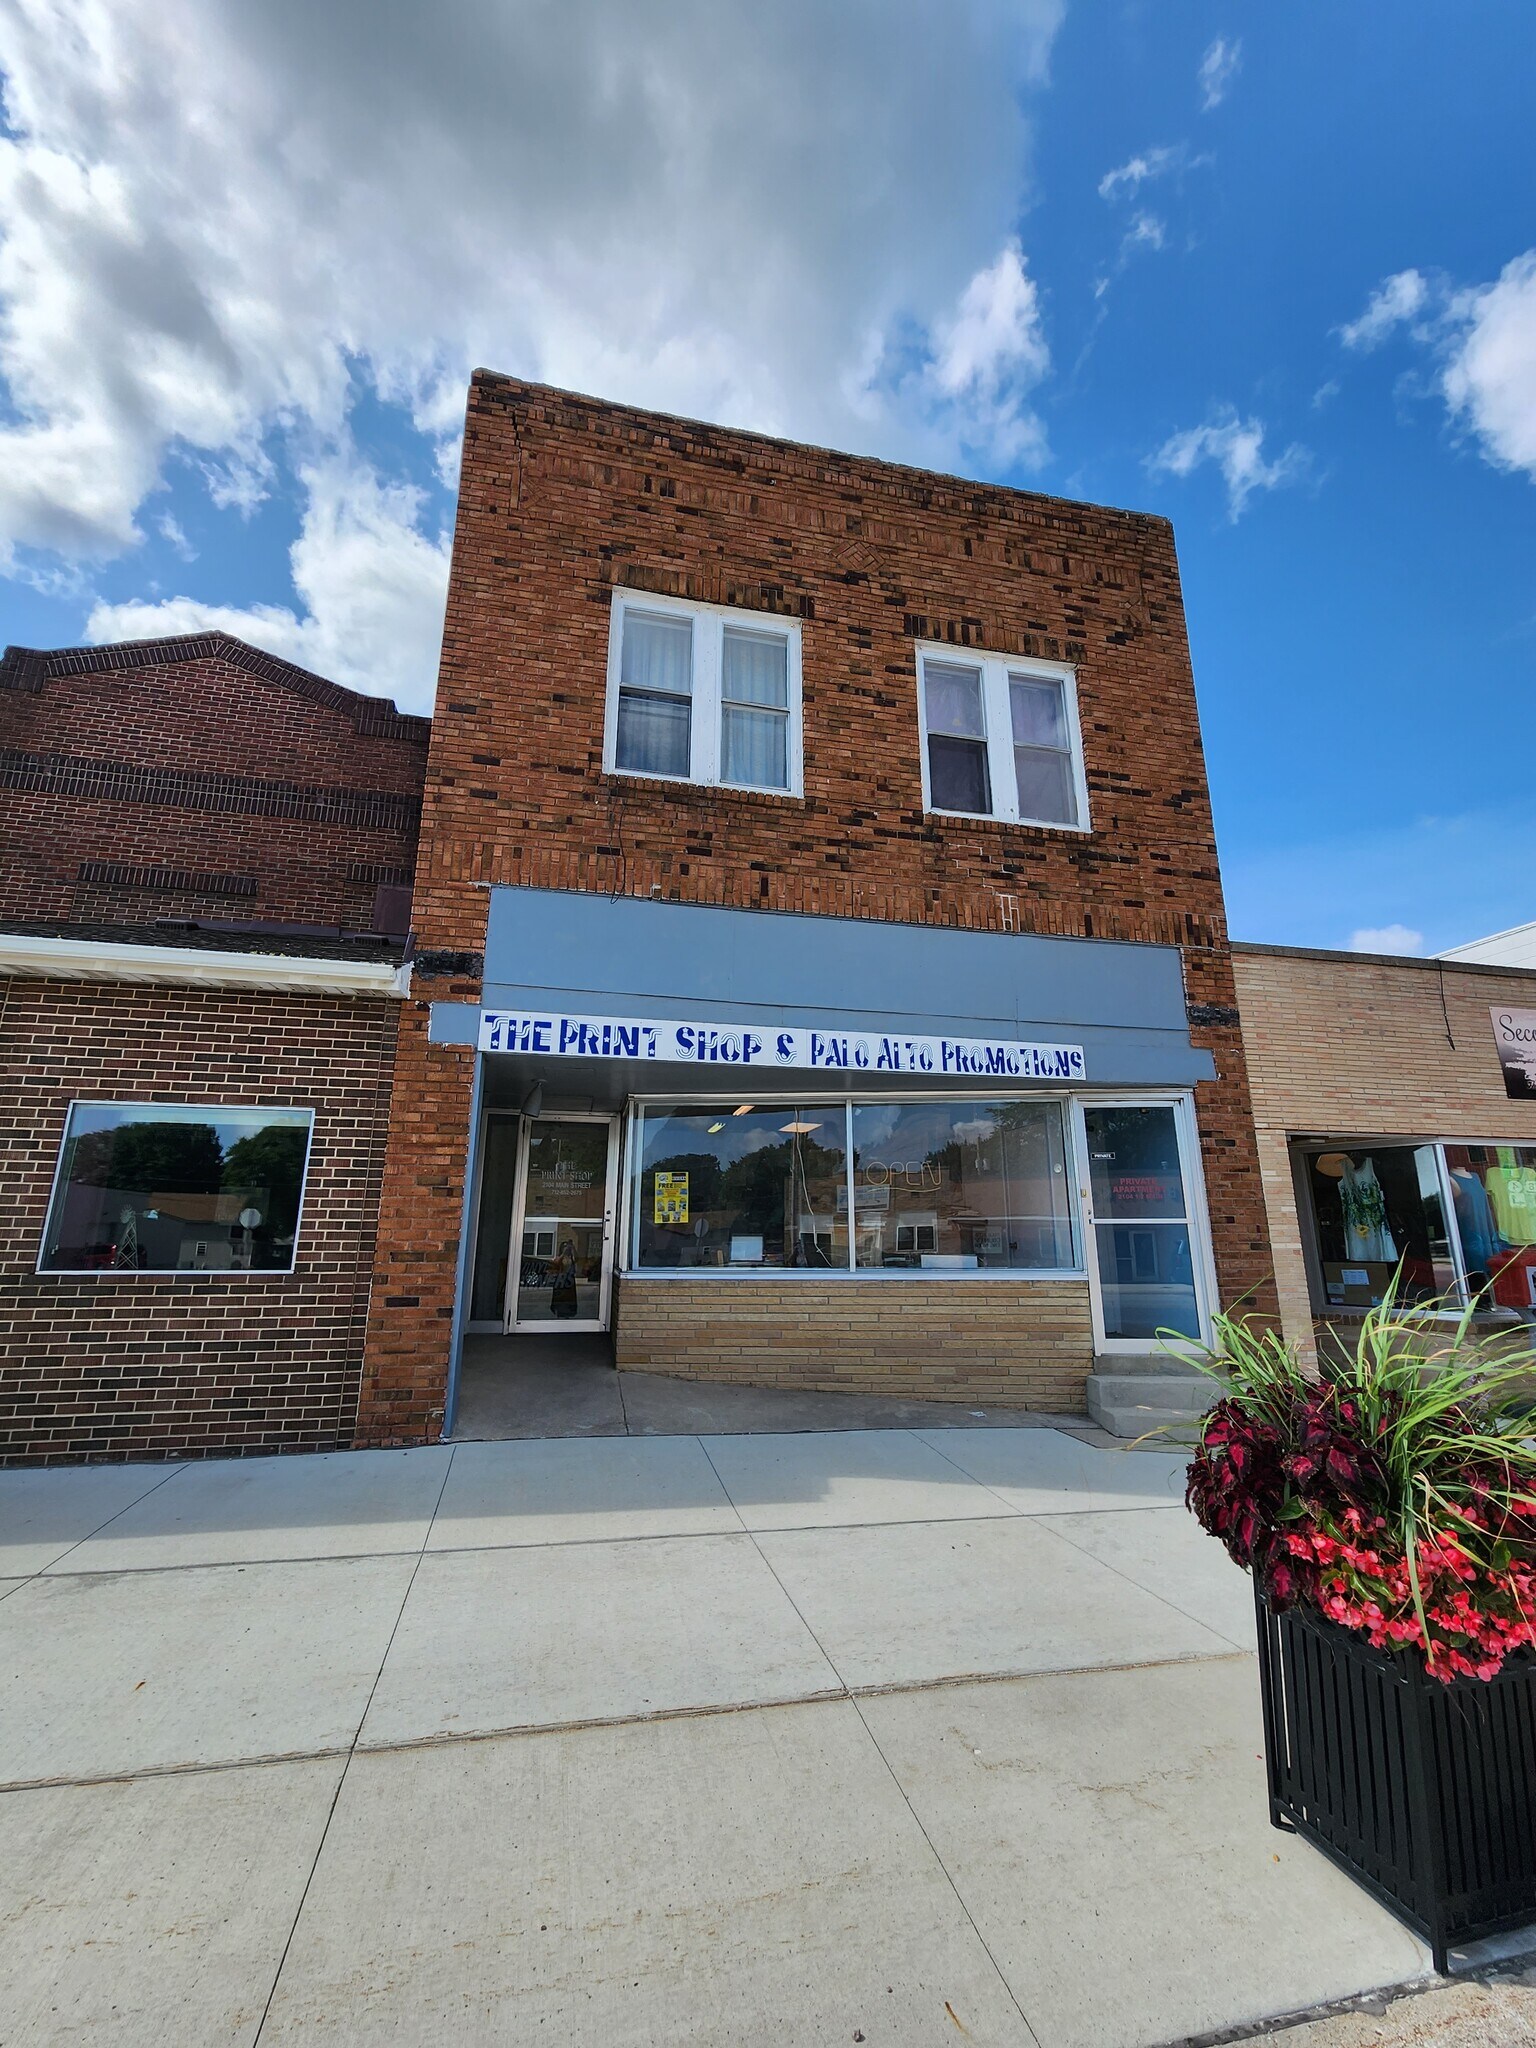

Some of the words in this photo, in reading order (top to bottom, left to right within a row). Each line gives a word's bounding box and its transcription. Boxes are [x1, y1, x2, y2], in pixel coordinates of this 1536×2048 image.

[484, 1014, 553, 1051] THE
[558, 1018, 663, 1057] PRINT
[675, 1026, 763, 1063] SHOP
[811, 1033, 870, 1068] PALO
[877, 1037, 934, 1071] ALTO
[941, 1040, 1084, 1078] PROMOTIONS
[866, 1160, 942, 1187] OPEN
[1119, 1177, 1158, 1185] PRIVATE
